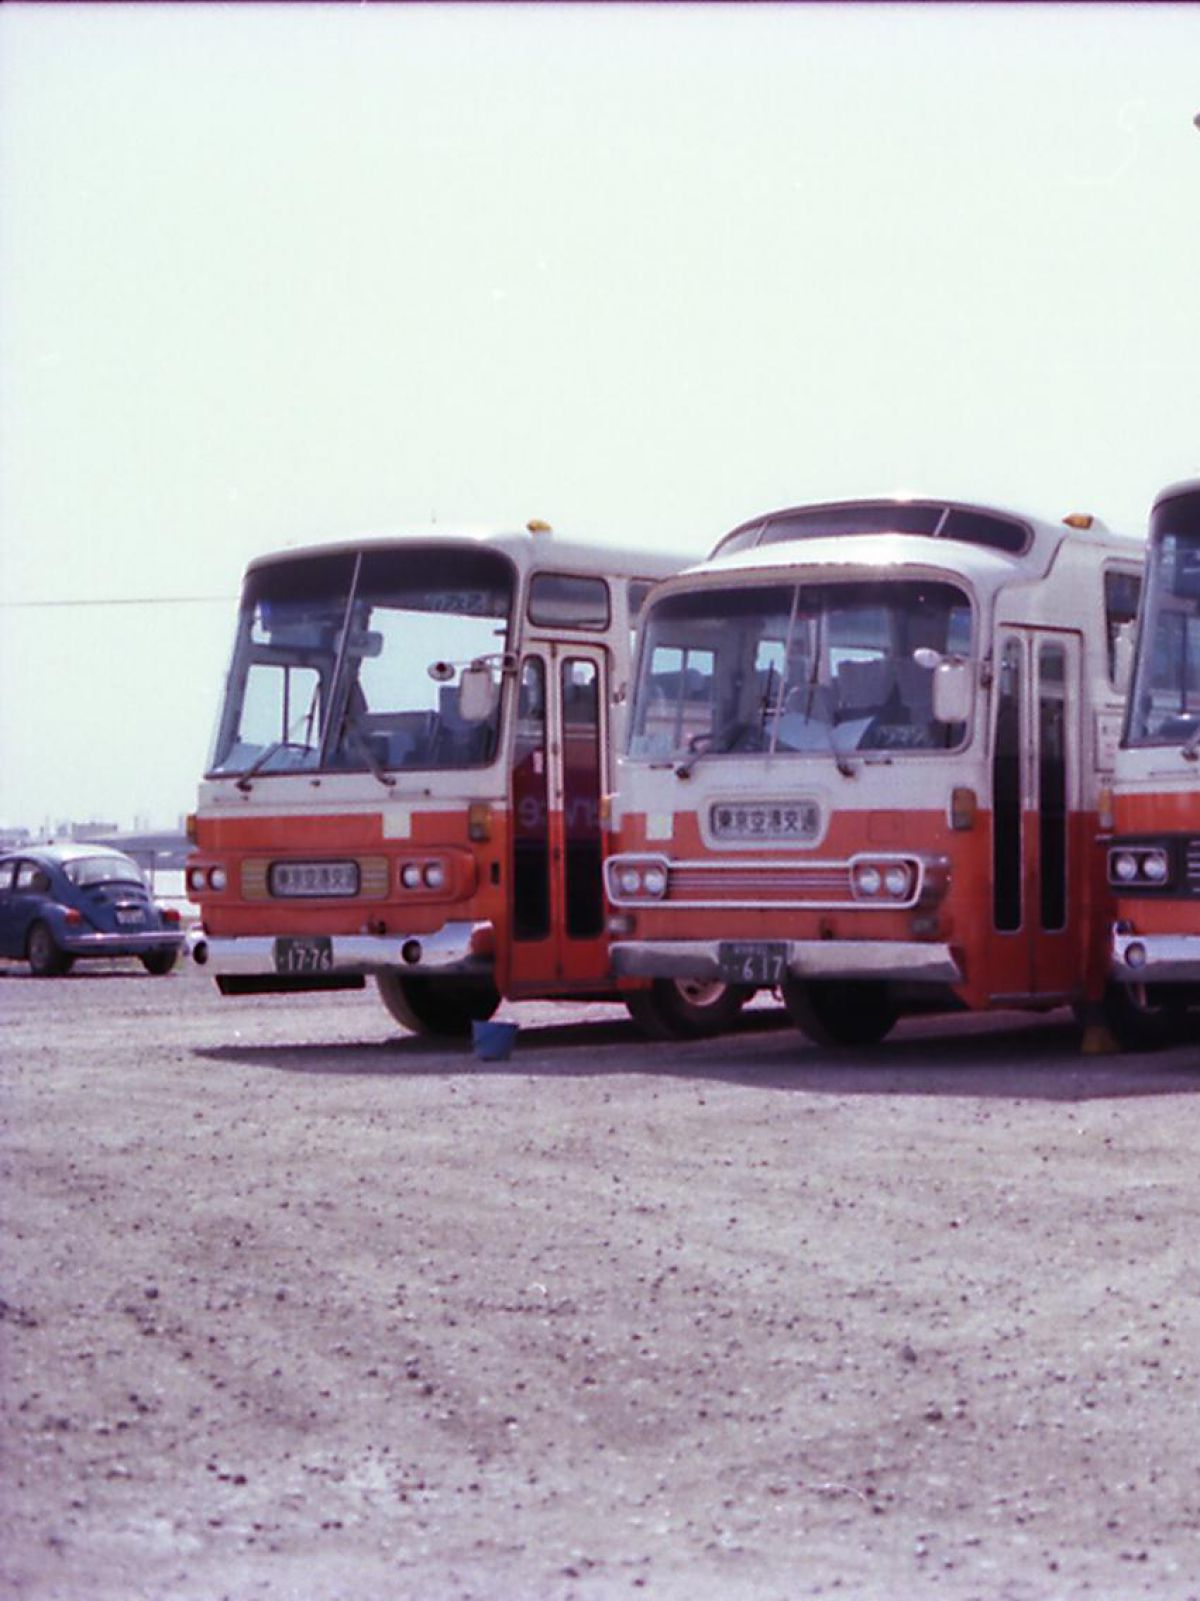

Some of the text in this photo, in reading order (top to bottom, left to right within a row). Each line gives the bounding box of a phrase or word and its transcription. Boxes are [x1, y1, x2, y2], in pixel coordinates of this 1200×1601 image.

[719, 808, 818, 834] 東京空港交通
